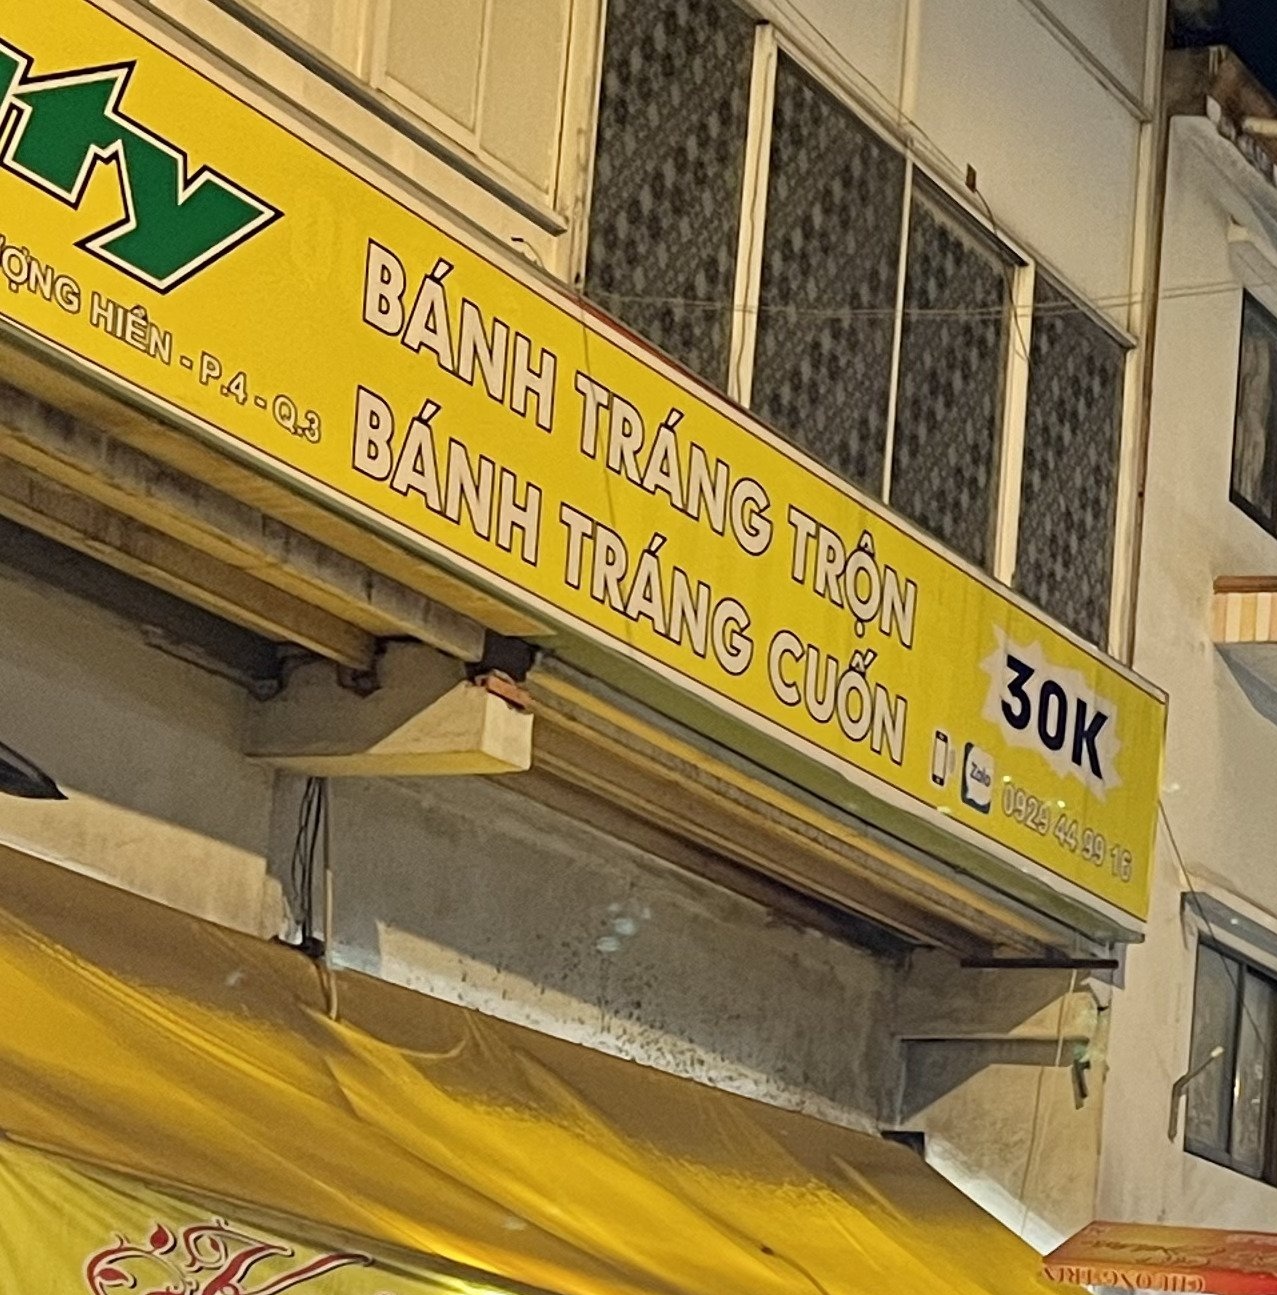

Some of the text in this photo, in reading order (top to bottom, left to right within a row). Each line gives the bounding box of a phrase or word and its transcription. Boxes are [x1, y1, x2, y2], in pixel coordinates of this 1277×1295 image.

[200, 350, 248, 405] P.4
[272, 393, 322, 443] Q.3
[361, 237, 918, 650] BÁNH TRÁNG TRỘN
[350, 384, 908, 766] BÁNH TRÁNG CUỐN
[1001, 653, 1108, 780] 30K
[1052, 812, 1080, 854] 44
